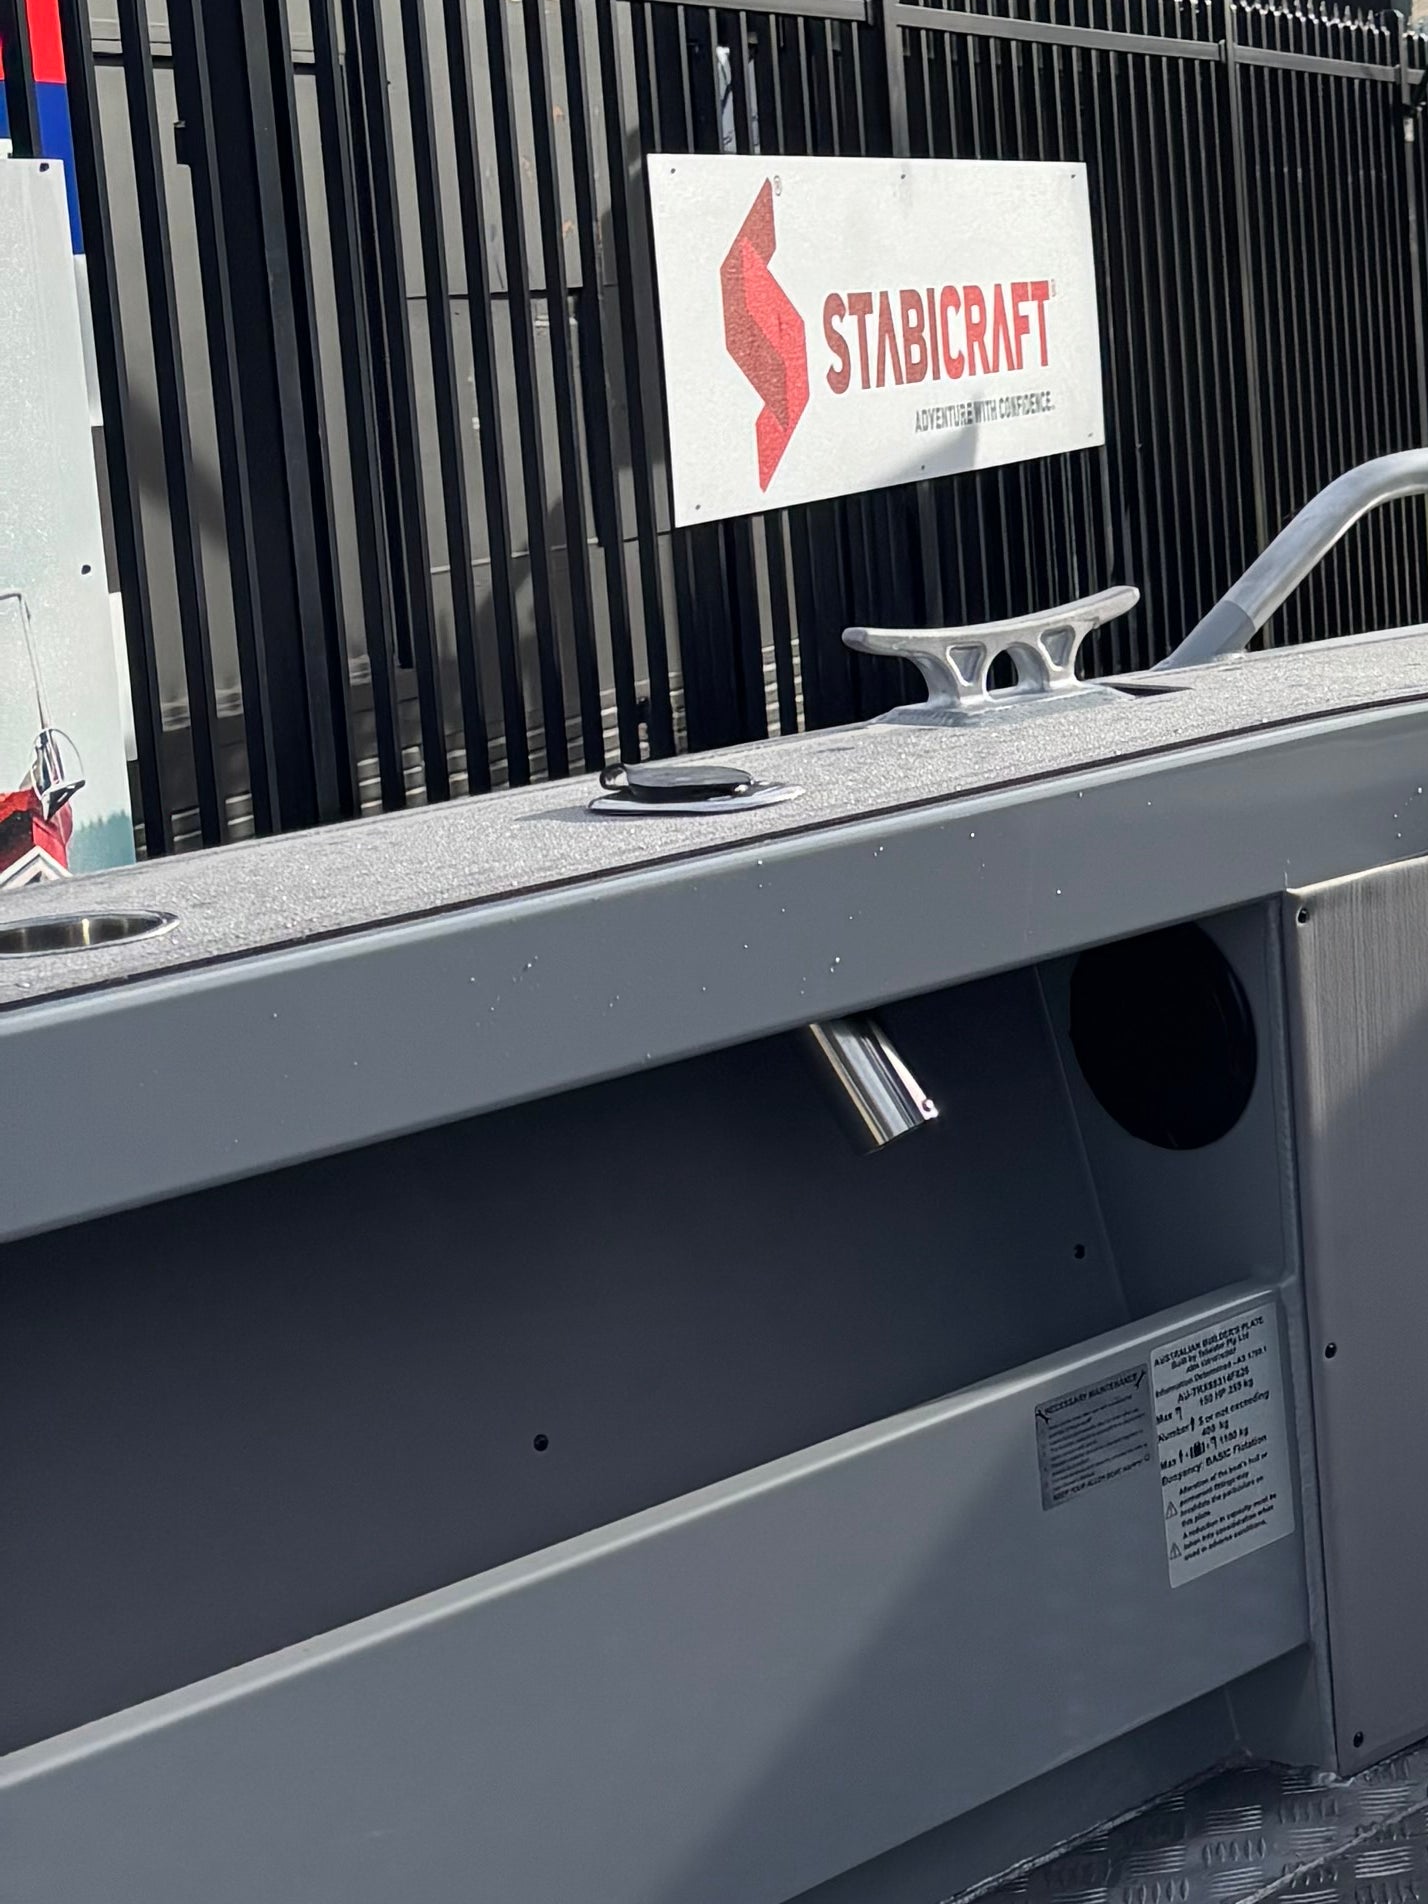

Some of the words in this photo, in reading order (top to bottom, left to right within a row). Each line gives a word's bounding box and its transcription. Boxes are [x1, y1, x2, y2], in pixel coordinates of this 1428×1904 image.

[822, 280, 1050, 395] STABICRAFT
[915, 402, 973, 433] ADVENTURE
[973, 399, 998, 423] WITH
[1205, 1448, 1230, 1466] BASIC
